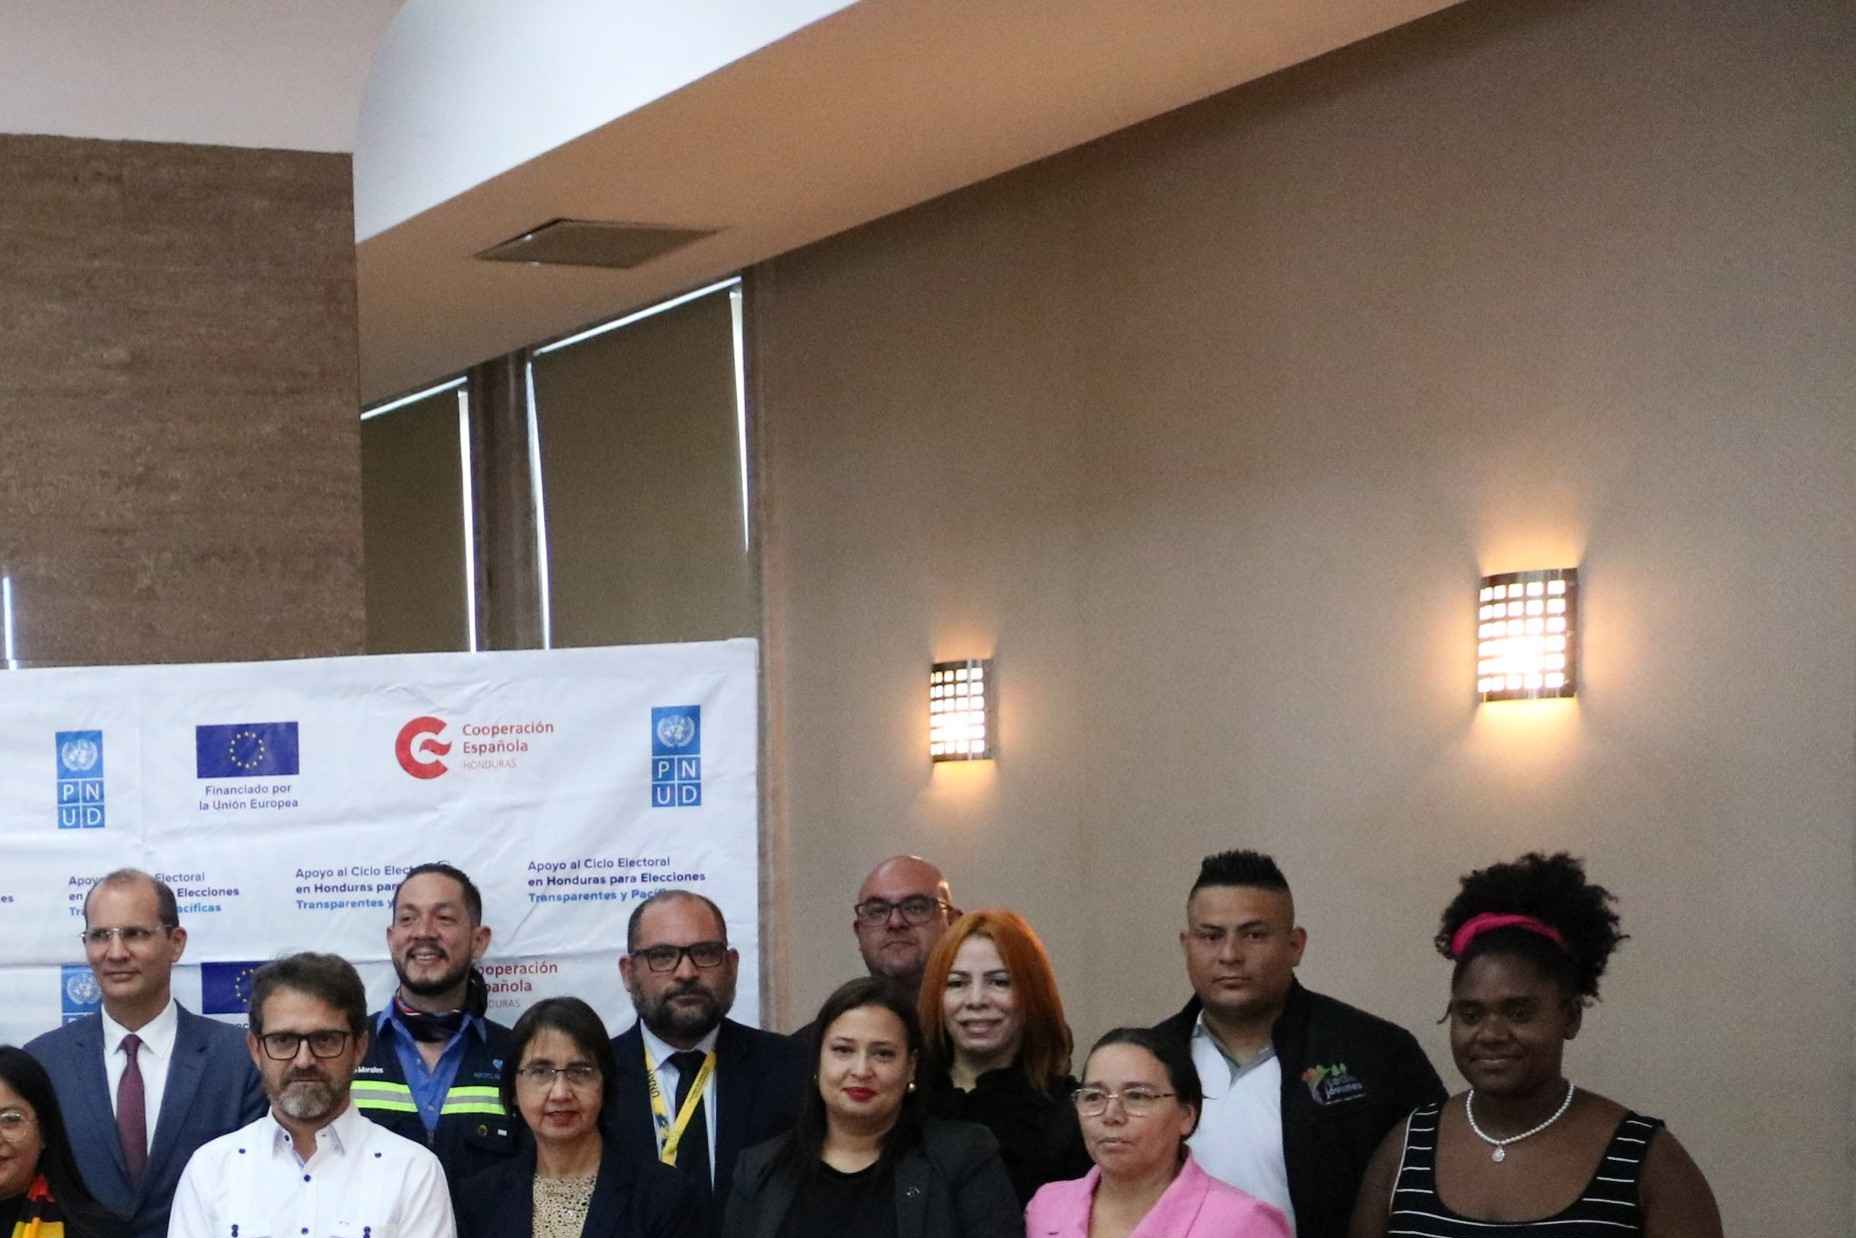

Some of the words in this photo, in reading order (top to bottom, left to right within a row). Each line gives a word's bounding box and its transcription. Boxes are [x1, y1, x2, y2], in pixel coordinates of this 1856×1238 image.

[462, 720, 554, 738] Cooperación
[463, 739, 529, 756] Española
[463, 759, 518, 769] HONDURAS
[205, 784, 269, 796] Financiado
[272, 784, 292, 796] por
[199, 801, 209, 811] la
[212, 799, 247, 810] Unión
[250, 799, 299, 811] Europea
[528, 861, 567, 873] Apoyo
[570, 859, 581, 869] al
[584, 858, 614, 869] Ciclo
[617, 856, 671, 868] Electoral
[154, 872, 205, 883] Electoral
[295, 867, 335, 880] Apoyo
[337, 866, 348, 876] al
[350, 865, 381, 877] Ciclo
[528, 878, 544, 887] en
[546, 875, 606, 887] Honduras
[609, 875, 637, 887] para
[640, 872, 706, 883] Elecciones
[68, 893, 84, 901] en
[177, 886, 240, 897] Elecciones
[295, 884, 311, 894] en
[313, 881, 373, 893] Honduras
[376, 883, 399, 894] par
[528, 892, 617, 904] Transparentes
[620, 891, 629, 902] y
[296, 899, 384, 911] Transparentes
[478, 960, 558, 978] ooperación
[485, 980, 533, 993] pañola
[488, 999, 521, 1009] DURAS
